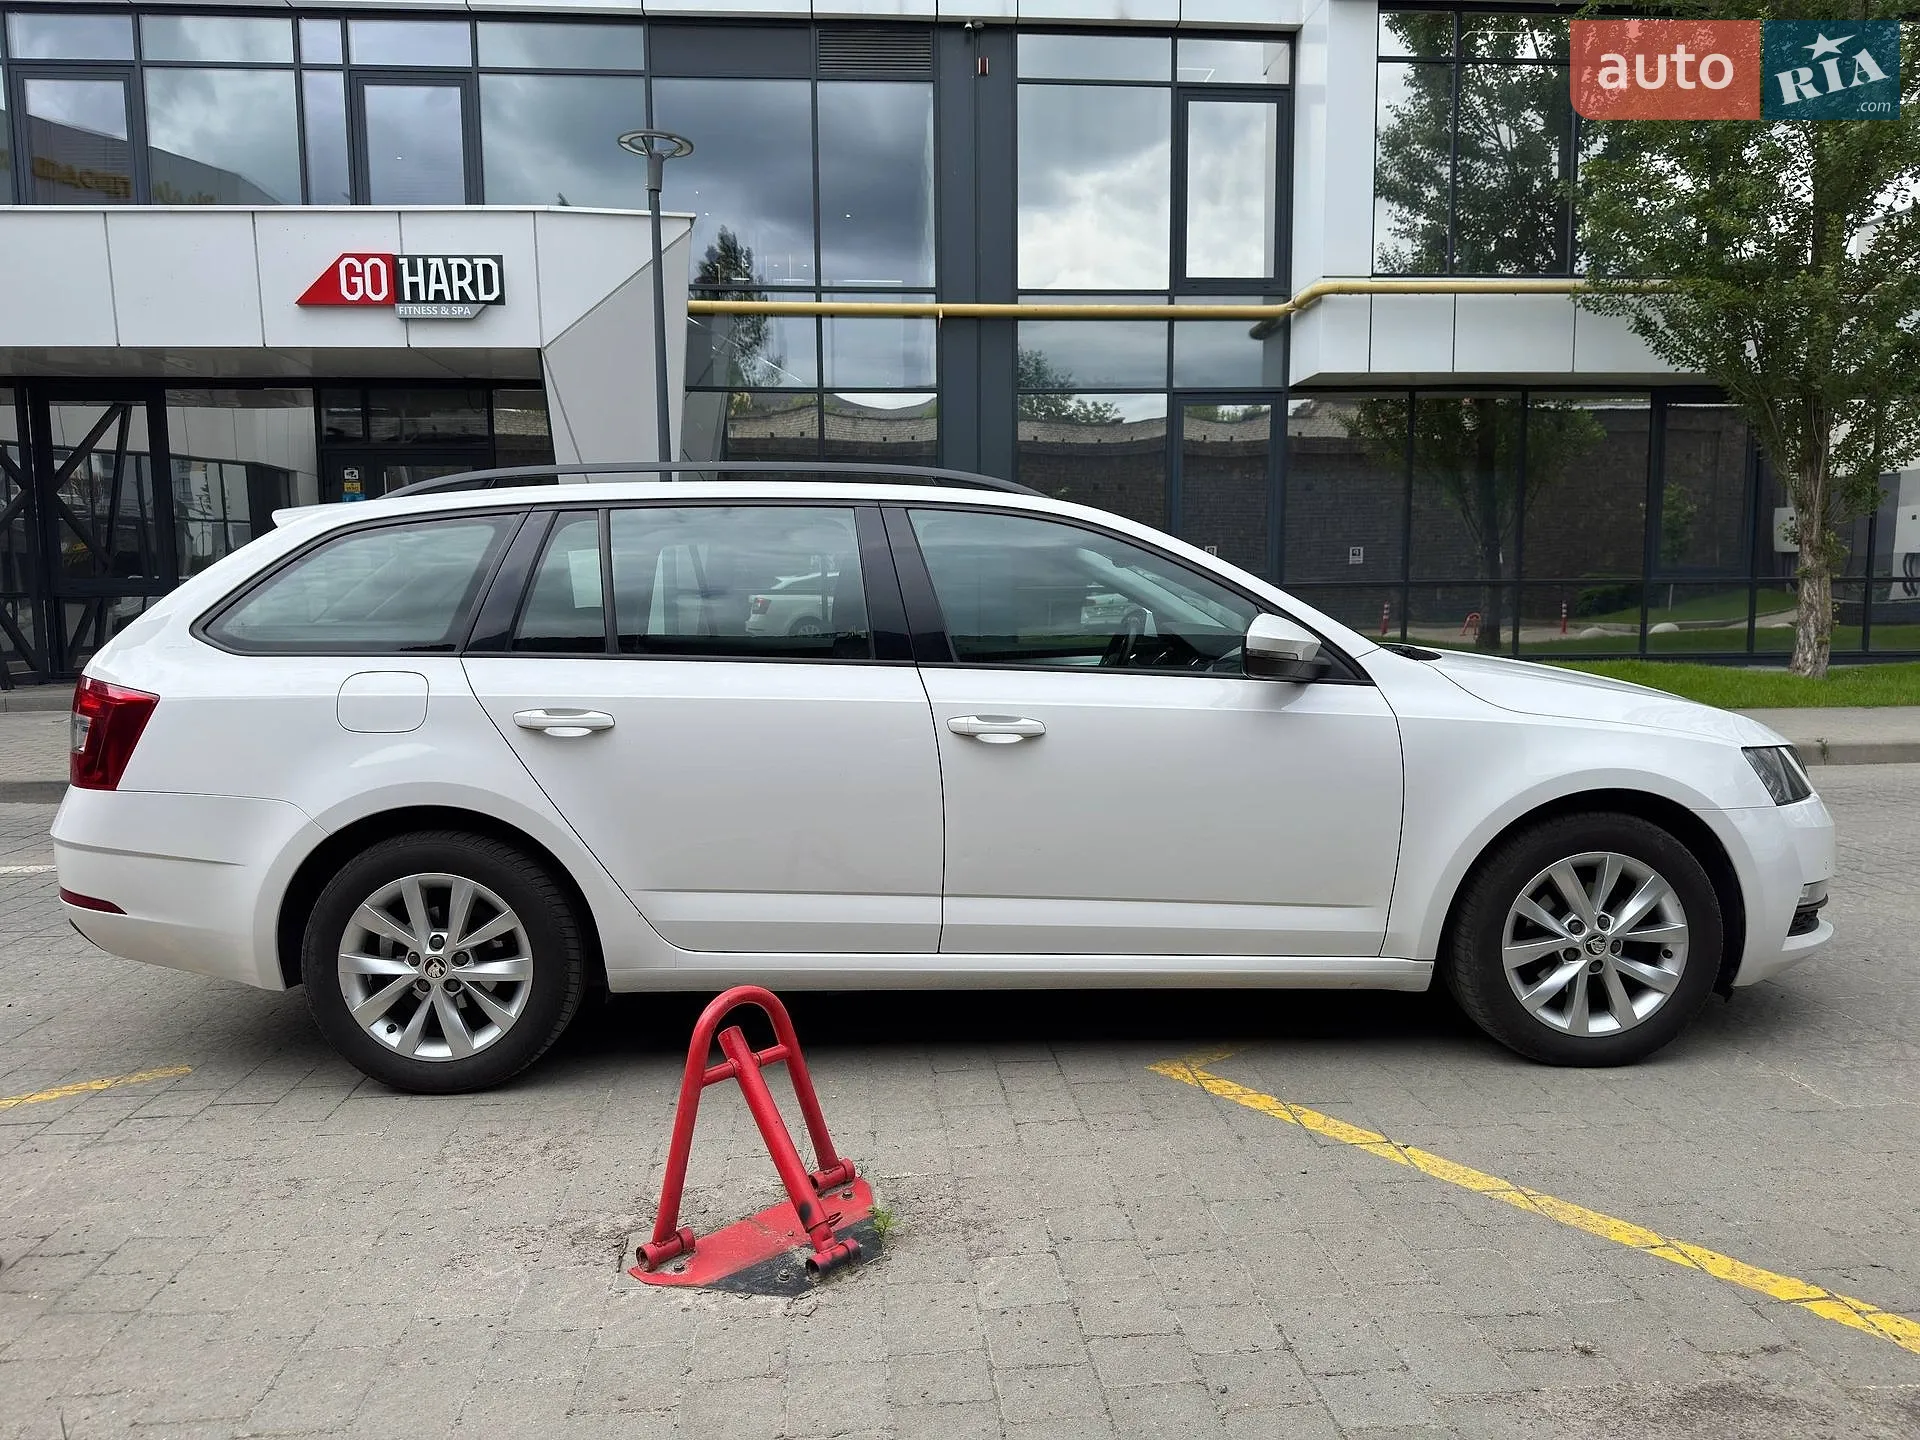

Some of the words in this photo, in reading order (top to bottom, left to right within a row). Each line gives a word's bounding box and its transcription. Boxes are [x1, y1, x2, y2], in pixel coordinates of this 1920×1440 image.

[338, 257, 389, 301] GO
[398, 257, 501, 301] HARD
[399, 306, 438, 316] FITNESS
[440, 306, 450, 315] &
[451, 306, 471, 315] SPA
